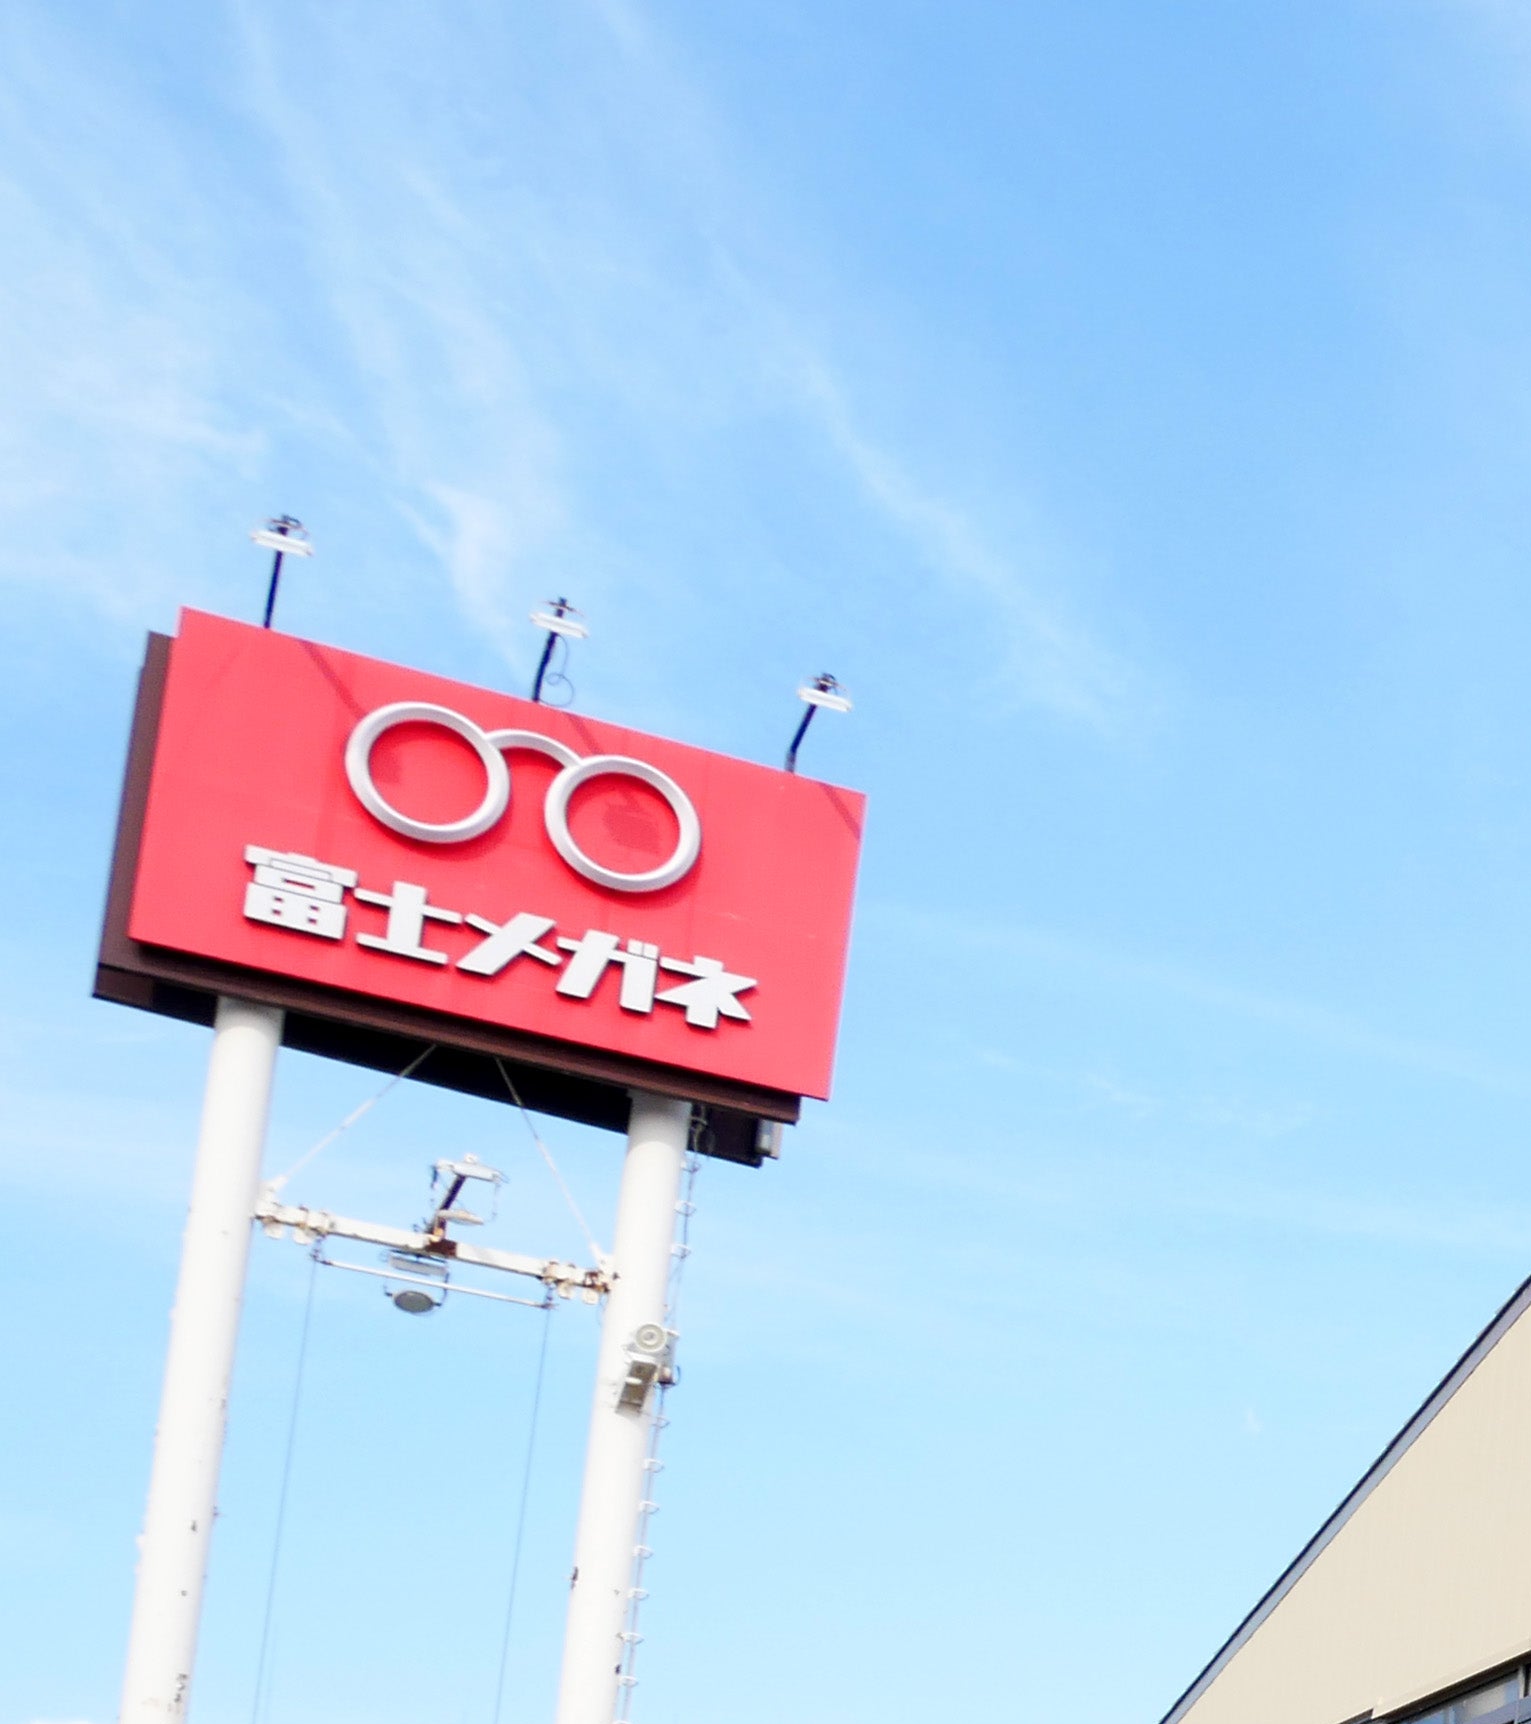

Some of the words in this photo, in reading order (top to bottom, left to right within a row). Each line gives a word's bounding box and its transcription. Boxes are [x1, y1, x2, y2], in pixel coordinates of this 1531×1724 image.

[243, 843, 758, 1030] 富士メガネ
